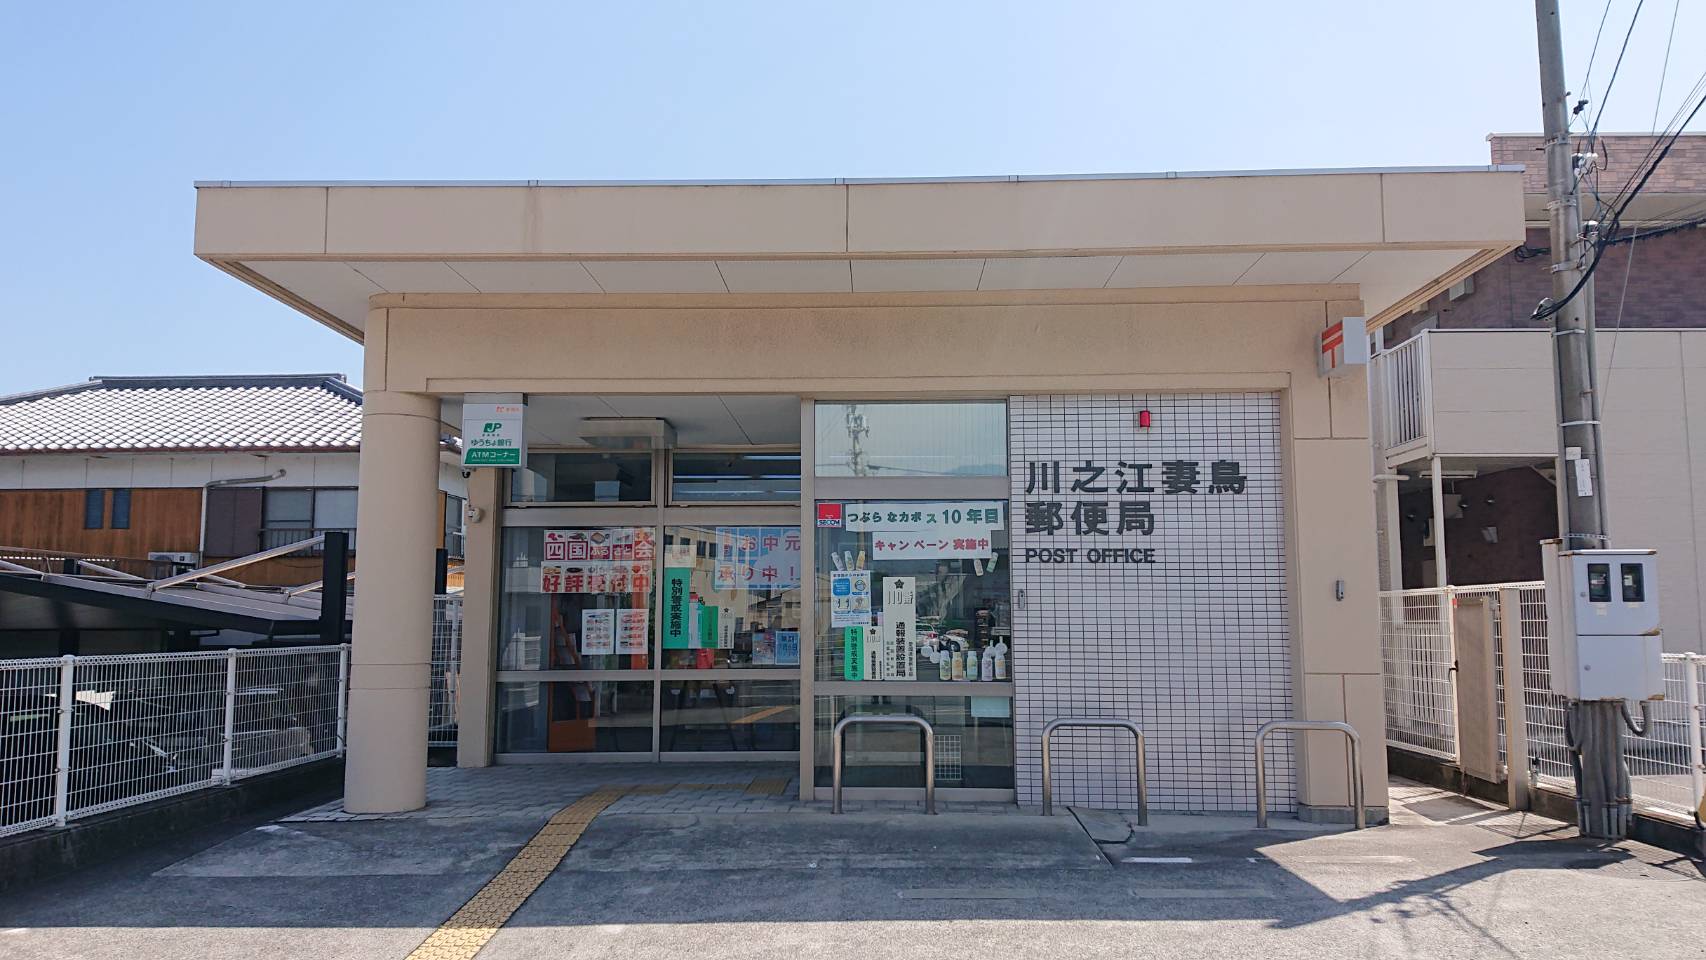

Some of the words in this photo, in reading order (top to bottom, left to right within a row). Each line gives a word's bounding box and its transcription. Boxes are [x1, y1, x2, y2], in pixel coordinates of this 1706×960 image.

[471, 438, 512, 447] ゆうちょ銀行
[471, 451, 516, 459] ATMコーナー
[1026, 460, 1247, 494] 川之江妻鳥
[1025, 501, 1155, 536] 郵便局
[1025, 548, 1077, 564] POST
[1087, 548, 1155, 564] OFFICE
[670, 578, 684, 637] 特別警戒実施中
